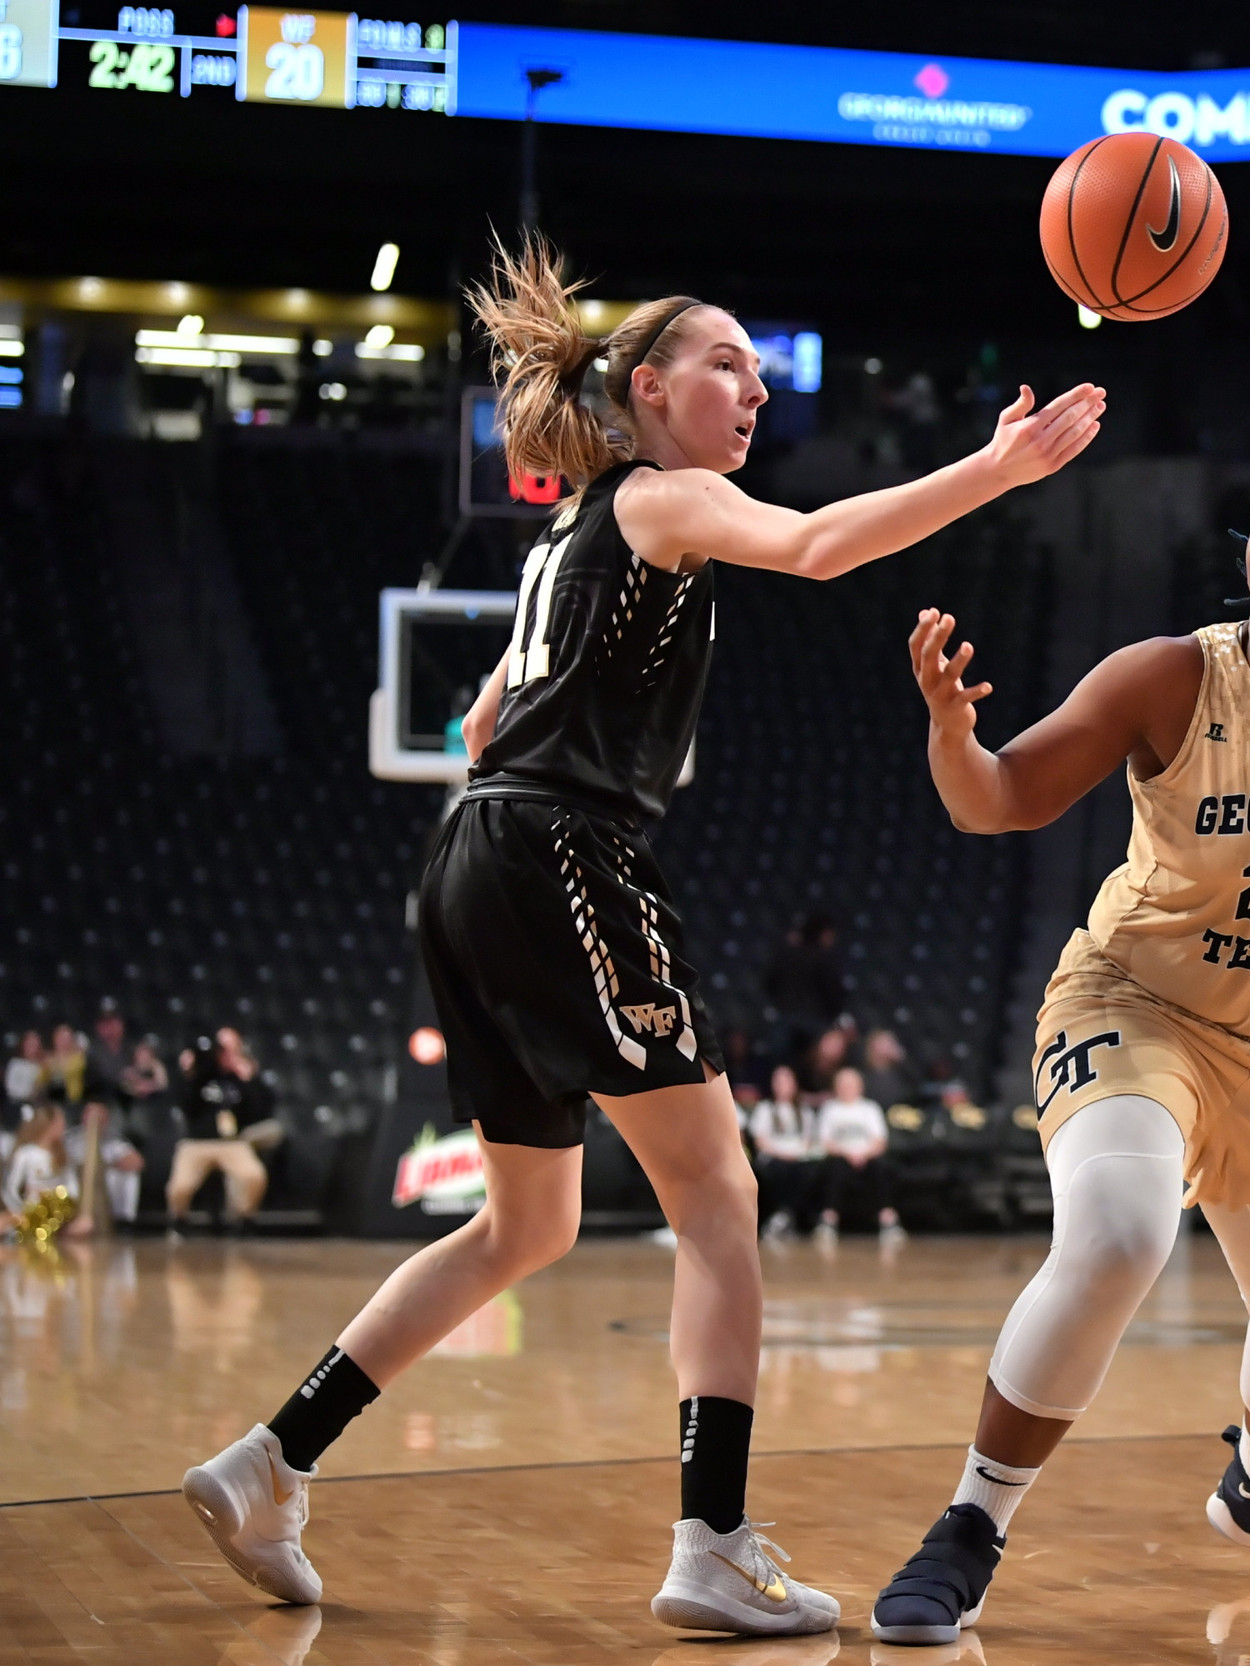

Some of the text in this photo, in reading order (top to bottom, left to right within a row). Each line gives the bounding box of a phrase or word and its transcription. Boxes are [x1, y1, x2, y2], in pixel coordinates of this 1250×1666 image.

[89, 40, 175, 92] 2:42
[265, 42, 323, 100] 20
[507, 532, 575, 690] 11
[619, 1002, 676, 1038] WF
